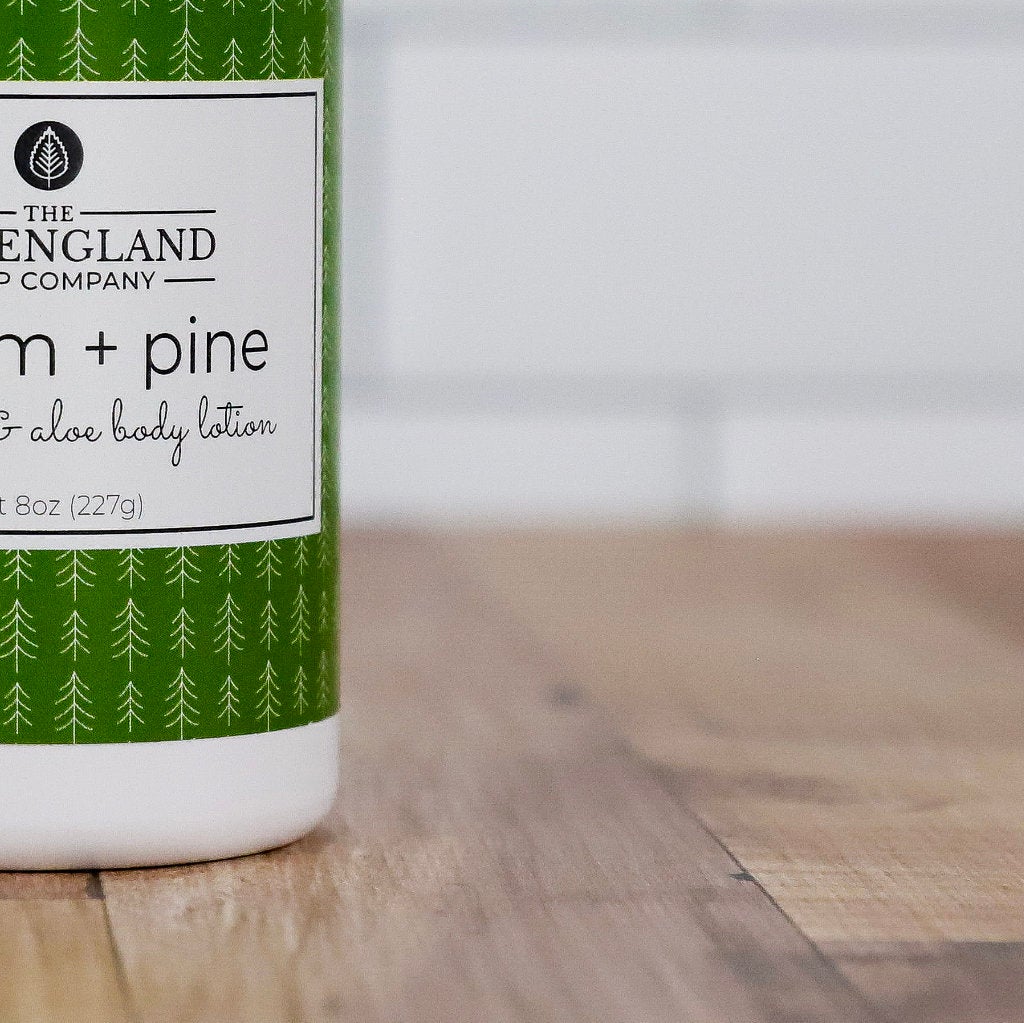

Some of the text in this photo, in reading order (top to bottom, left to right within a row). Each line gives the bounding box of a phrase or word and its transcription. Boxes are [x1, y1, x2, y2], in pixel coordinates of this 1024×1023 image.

[23, 204, 74, 222] THE
[20, 270, 156, 291] COMPANY
[85, 330, 118, 366] +
[145, 315, 269, 391] pine
[29, 398, 103, 443] aloe
[111, 397, 190, 468] body
[197, 394, 278, 440] lotion
[15, 494, 61, 516] 8oz
[69, 492, 144, 522] (227g)
